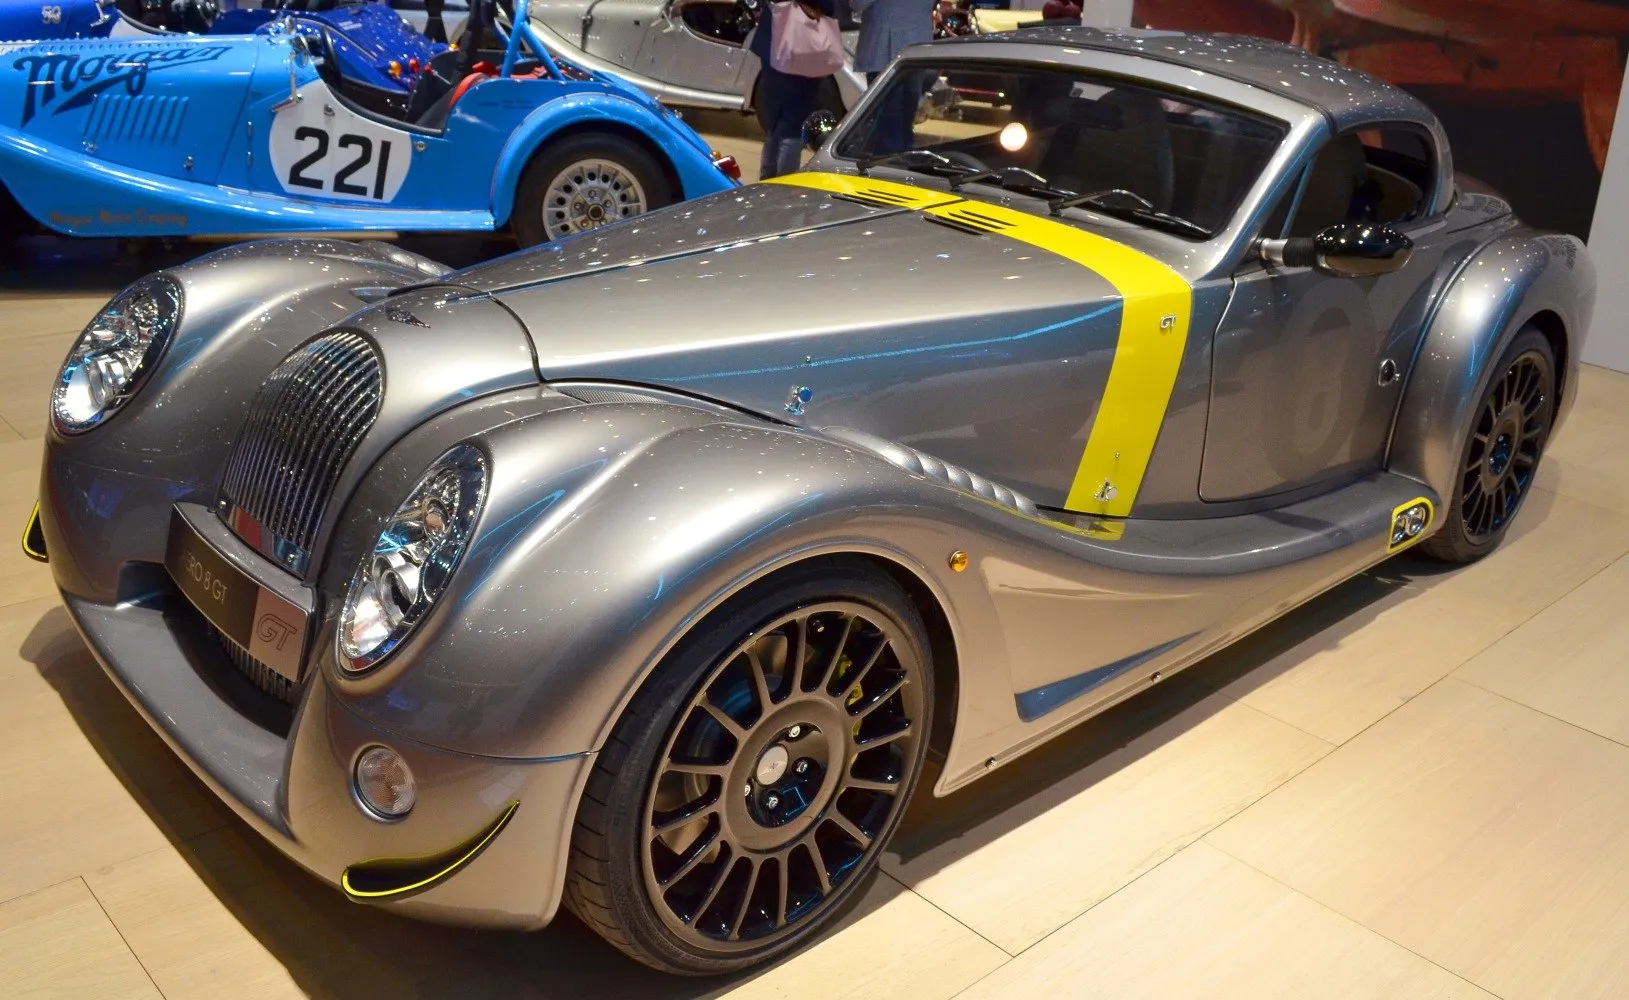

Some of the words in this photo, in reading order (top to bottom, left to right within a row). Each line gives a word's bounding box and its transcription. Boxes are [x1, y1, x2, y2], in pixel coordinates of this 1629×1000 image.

[13, 46, 233, 128] Morgan
[288, 126, 391, 200] 221
[1160, 315, 1176, 329] GT
[203, 571, 211, 590] 8
[212, 579, 227, 605] GT
[256, 613, 298, 651] GT
